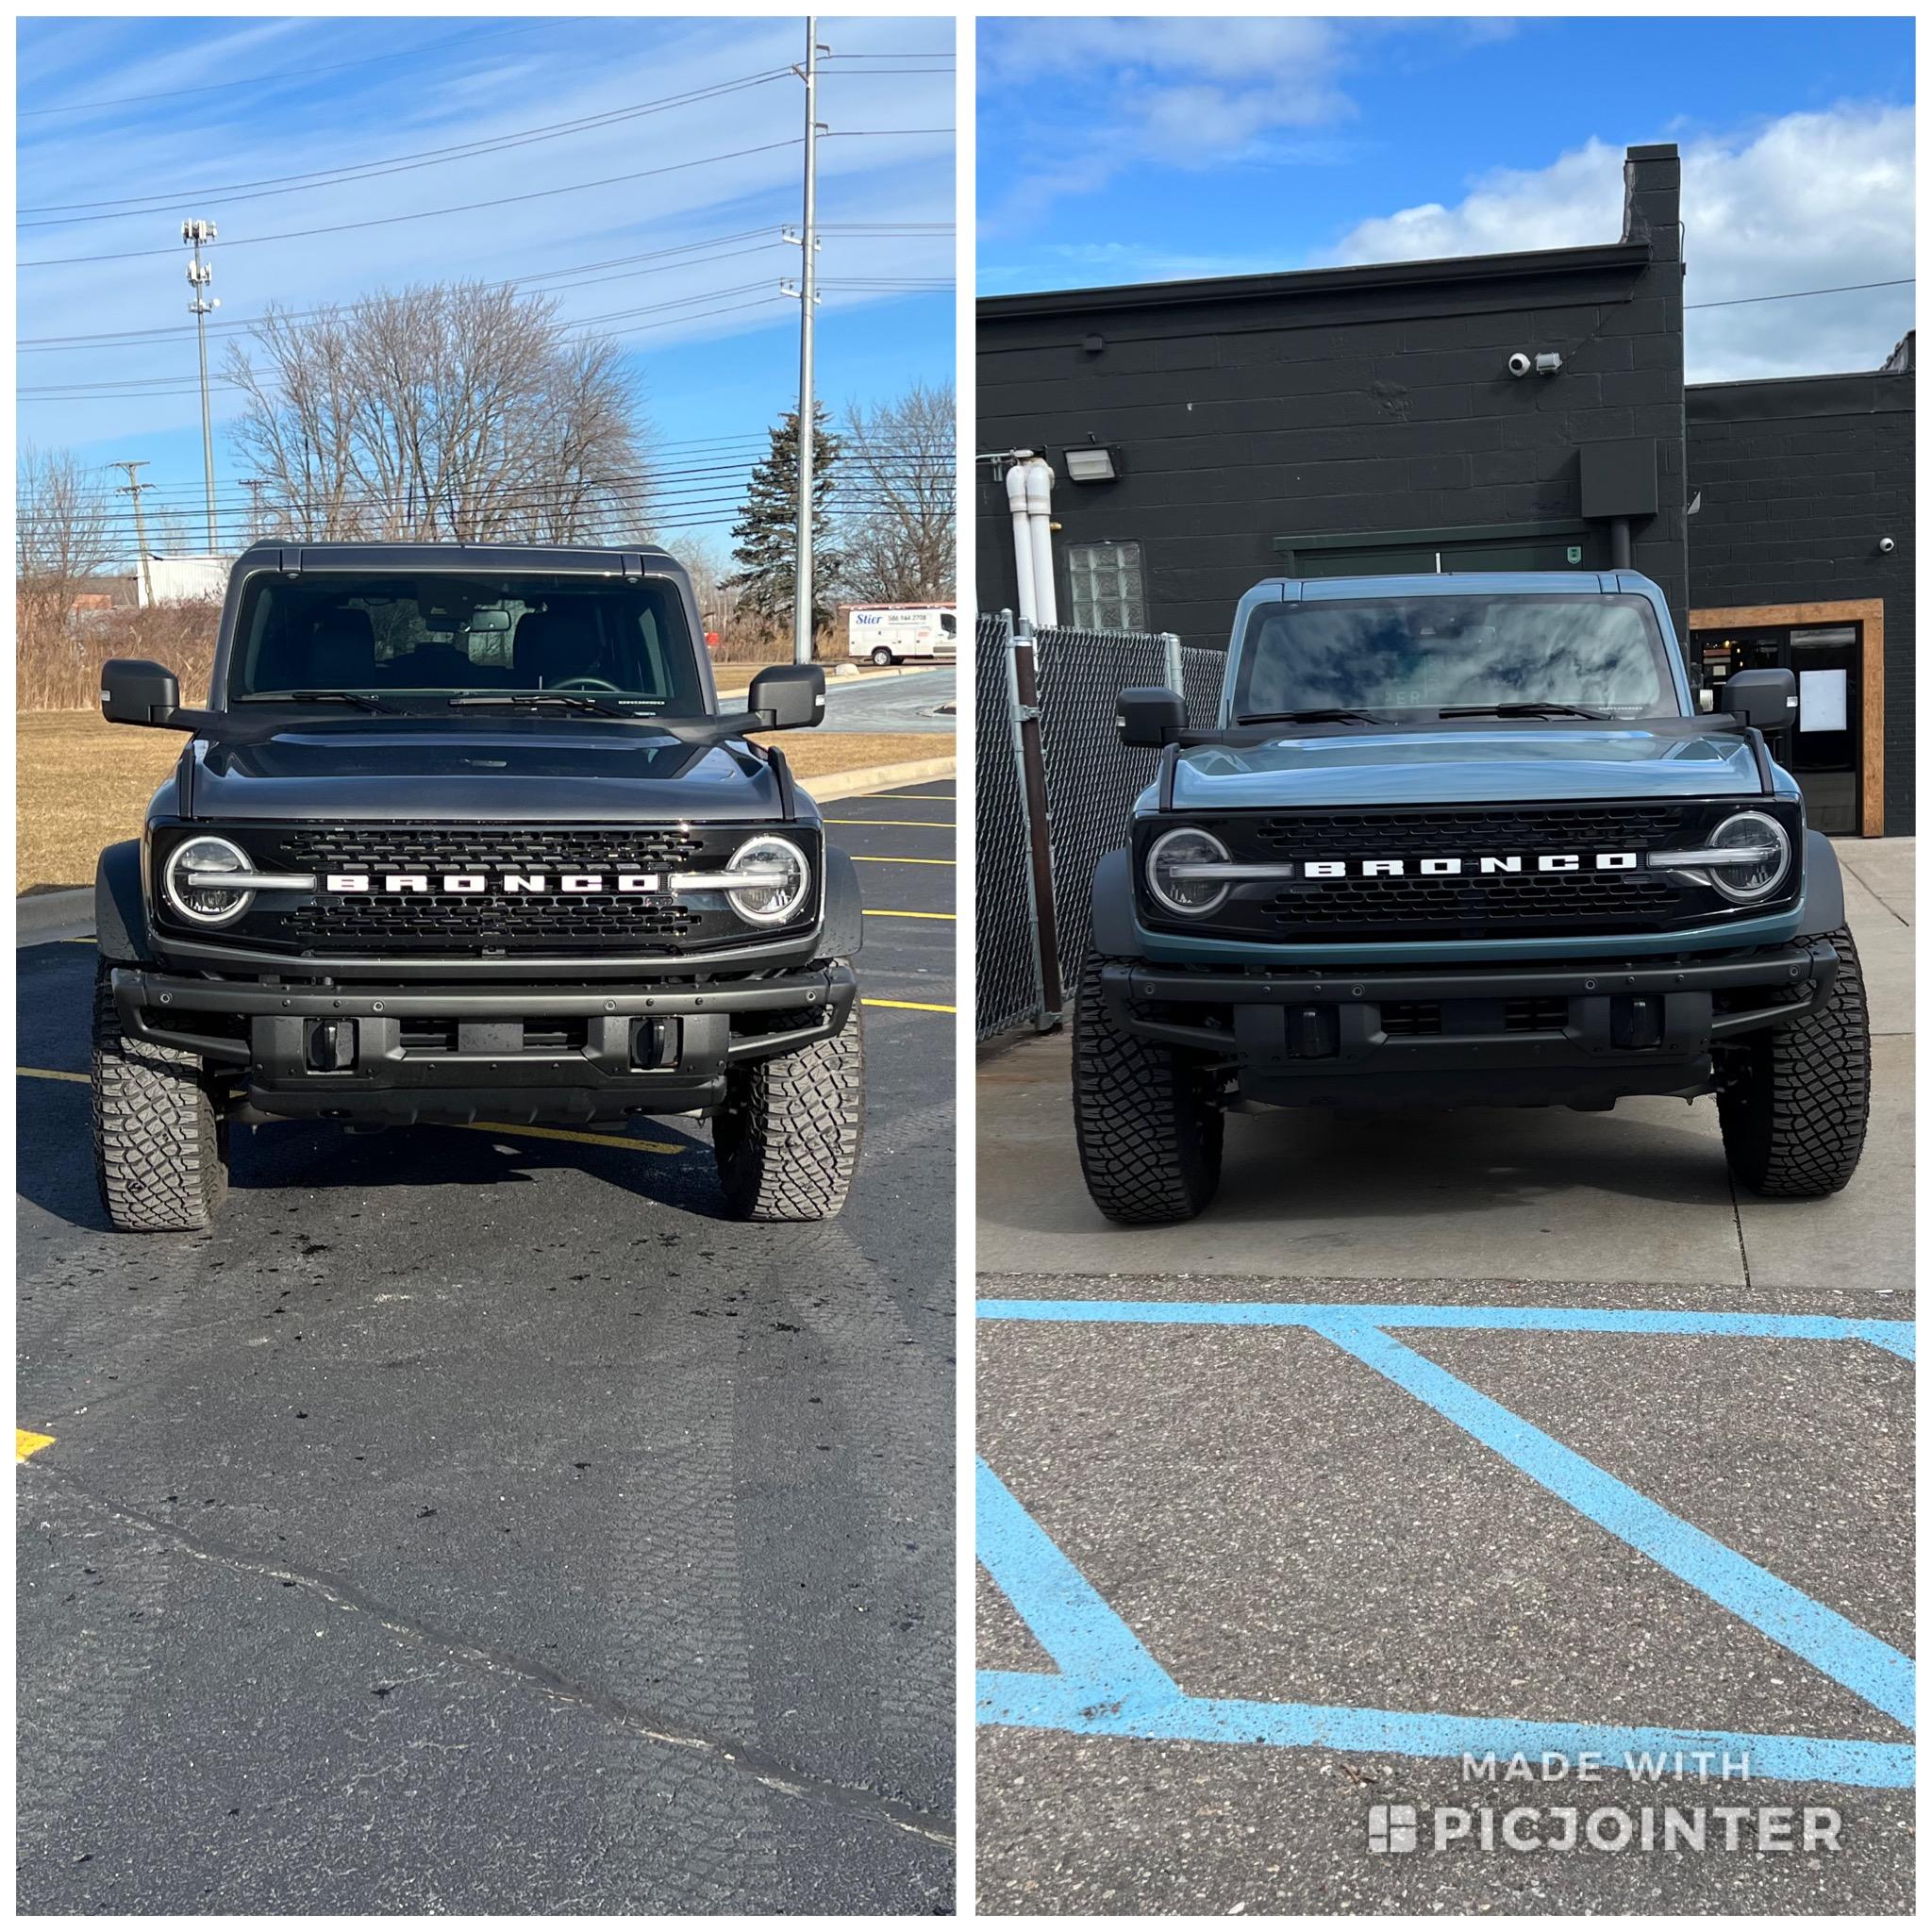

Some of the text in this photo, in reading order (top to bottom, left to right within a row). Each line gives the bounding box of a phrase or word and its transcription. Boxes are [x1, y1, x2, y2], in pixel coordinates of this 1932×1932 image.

[856, 613, 882, 625] Stier
[1304, 852, 1637, 878] BRONCO
[326, 874, 661, 892] BRONCO
